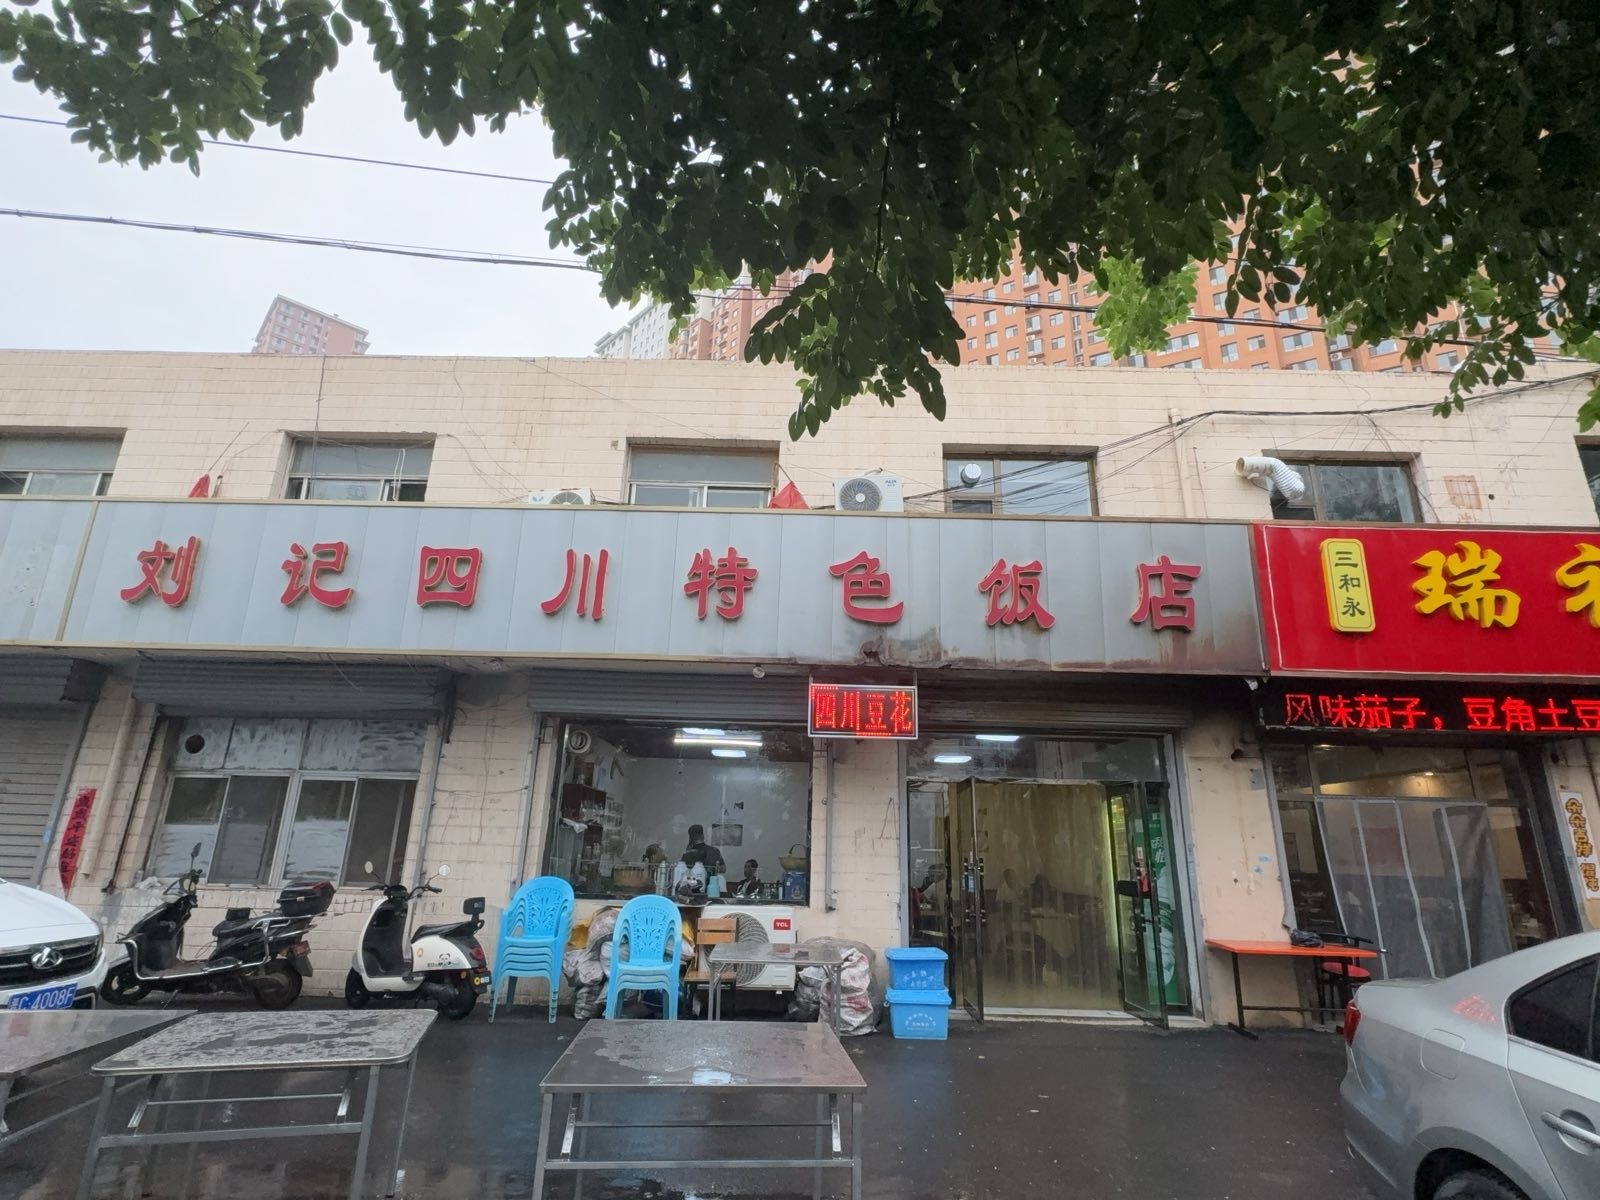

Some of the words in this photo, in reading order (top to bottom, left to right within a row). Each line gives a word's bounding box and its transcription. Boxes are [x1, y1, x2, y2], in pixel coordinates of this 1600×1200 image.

[121, 536, 1202, 632] 刘记四川特色饭店
[1334, 550, 1366, 618] 三和永
[814, 690, 913, 733] 四川豆花
